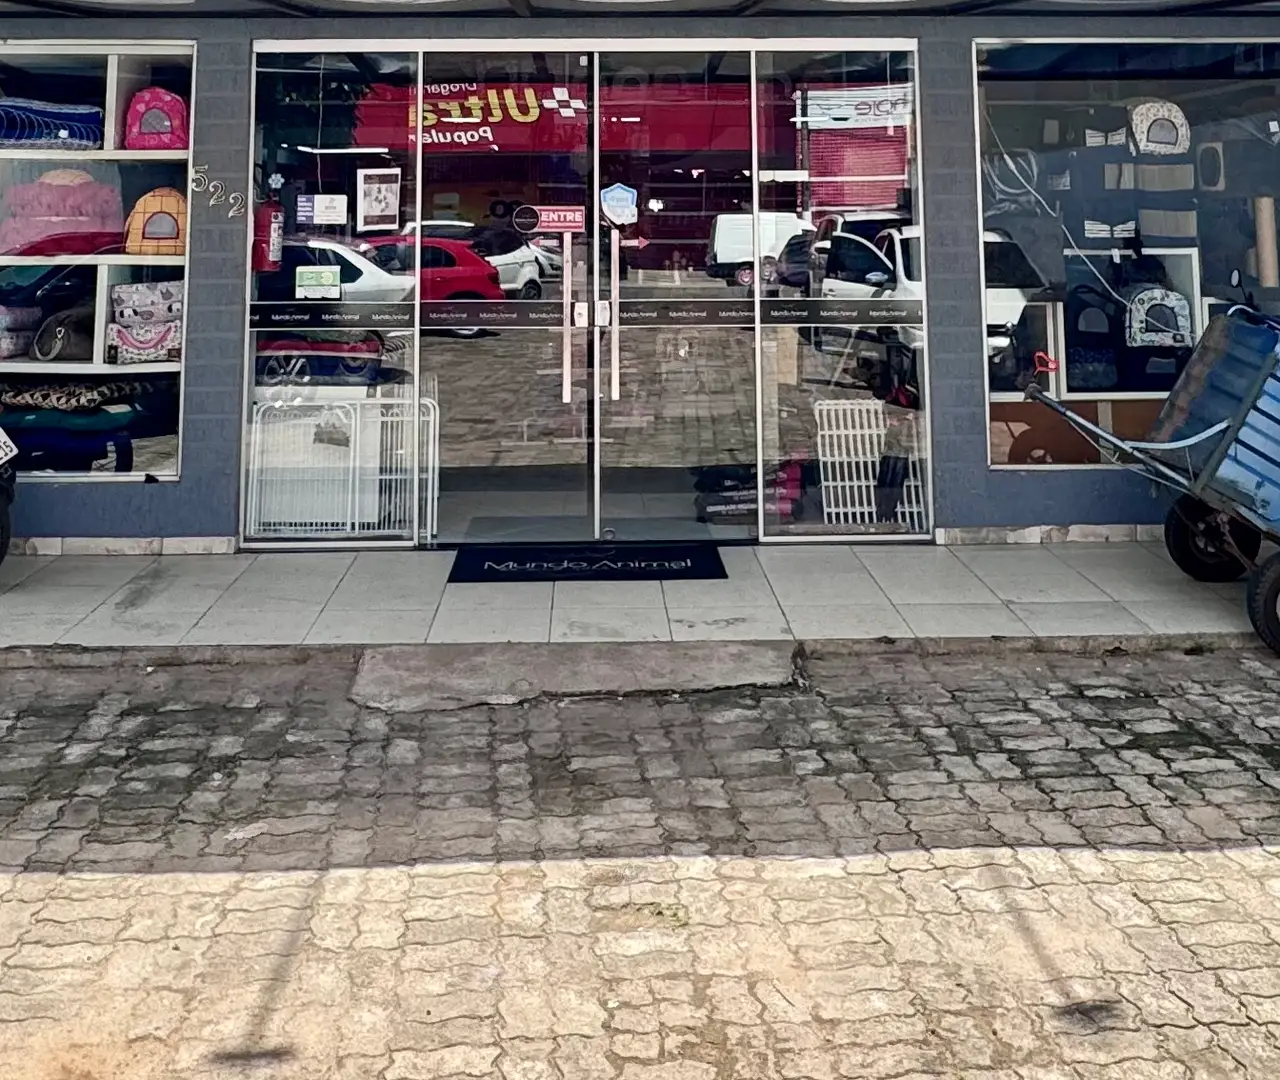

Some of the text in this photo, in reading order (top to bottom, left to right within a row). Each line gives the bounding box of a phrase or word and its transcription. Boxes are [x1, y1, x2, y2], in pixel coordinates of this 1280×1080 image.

[540, 211, 584, 222] ENTRE
[484, 558, 692, 570] Mundo Animal
